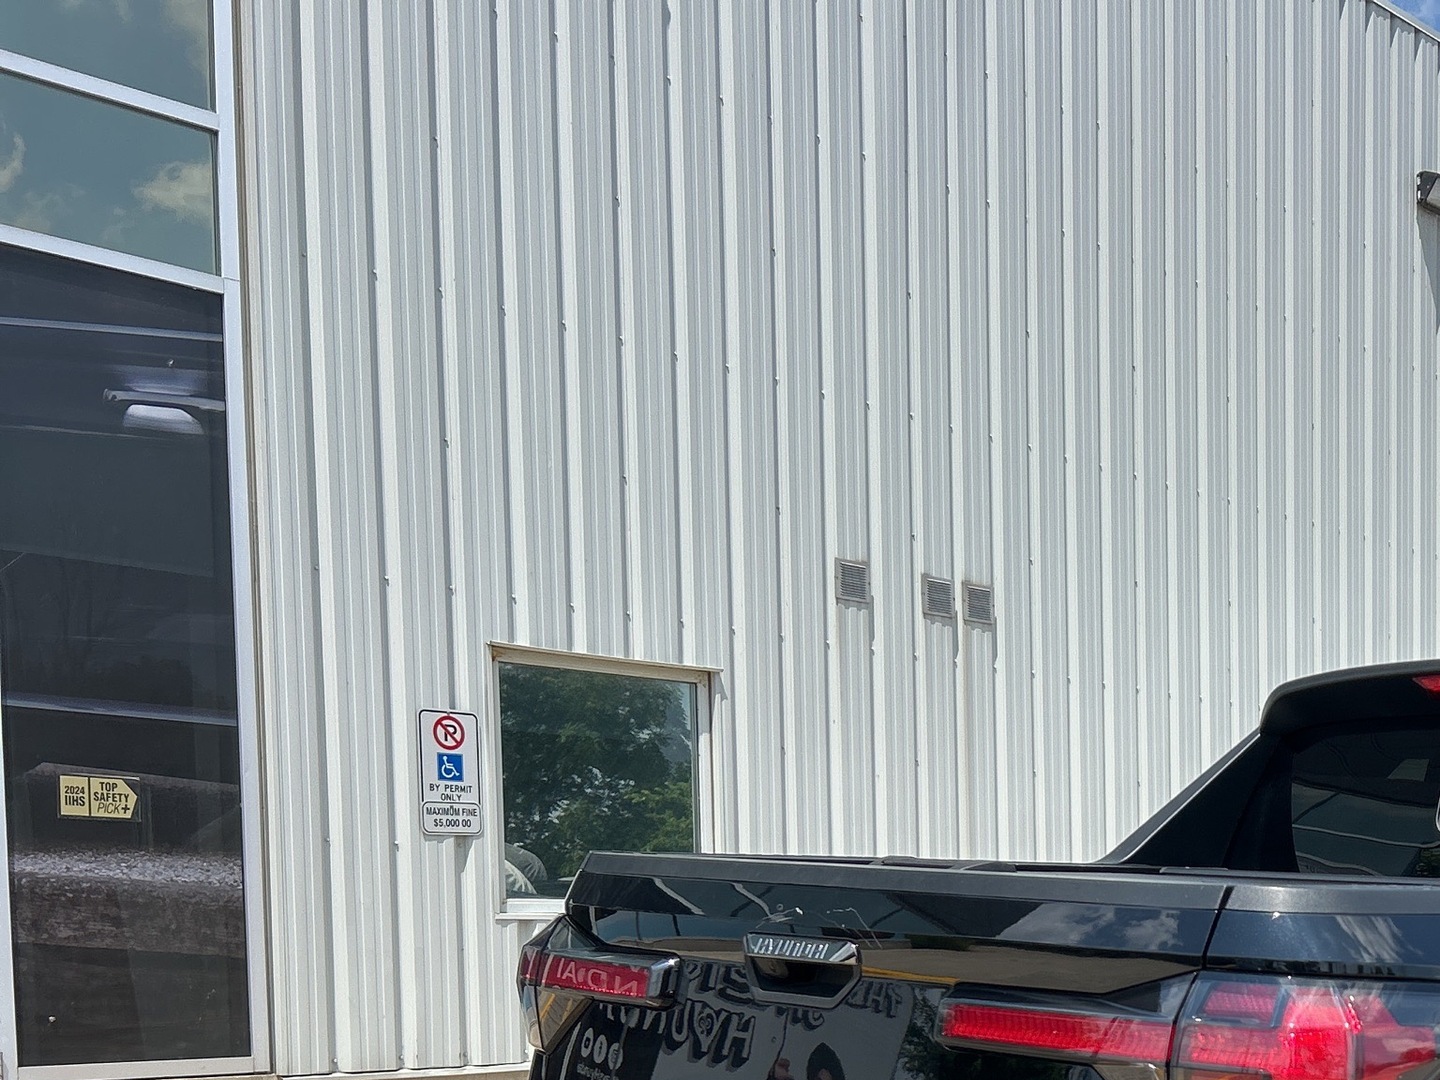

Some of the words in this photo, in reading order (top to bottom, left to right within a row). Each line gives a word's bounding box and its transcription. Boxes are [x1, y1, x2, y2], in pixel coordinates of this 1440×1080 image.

[64, 785, 85, 795] 2024
[99, 781, 118, 792] TOP
[429, 783, 440, 792] BY
[444, 784, 473, 794] PERMIT
[64, 794, 86, 807] IIHS
[93, 791, 130, 803] SAFETY
[440, 792, 462, 802] ONLY
[97, 802, 130, 815] PICK+
[426, 806, 460, 817] MAXIMUM
[461, 808, 478, 817] FINE
